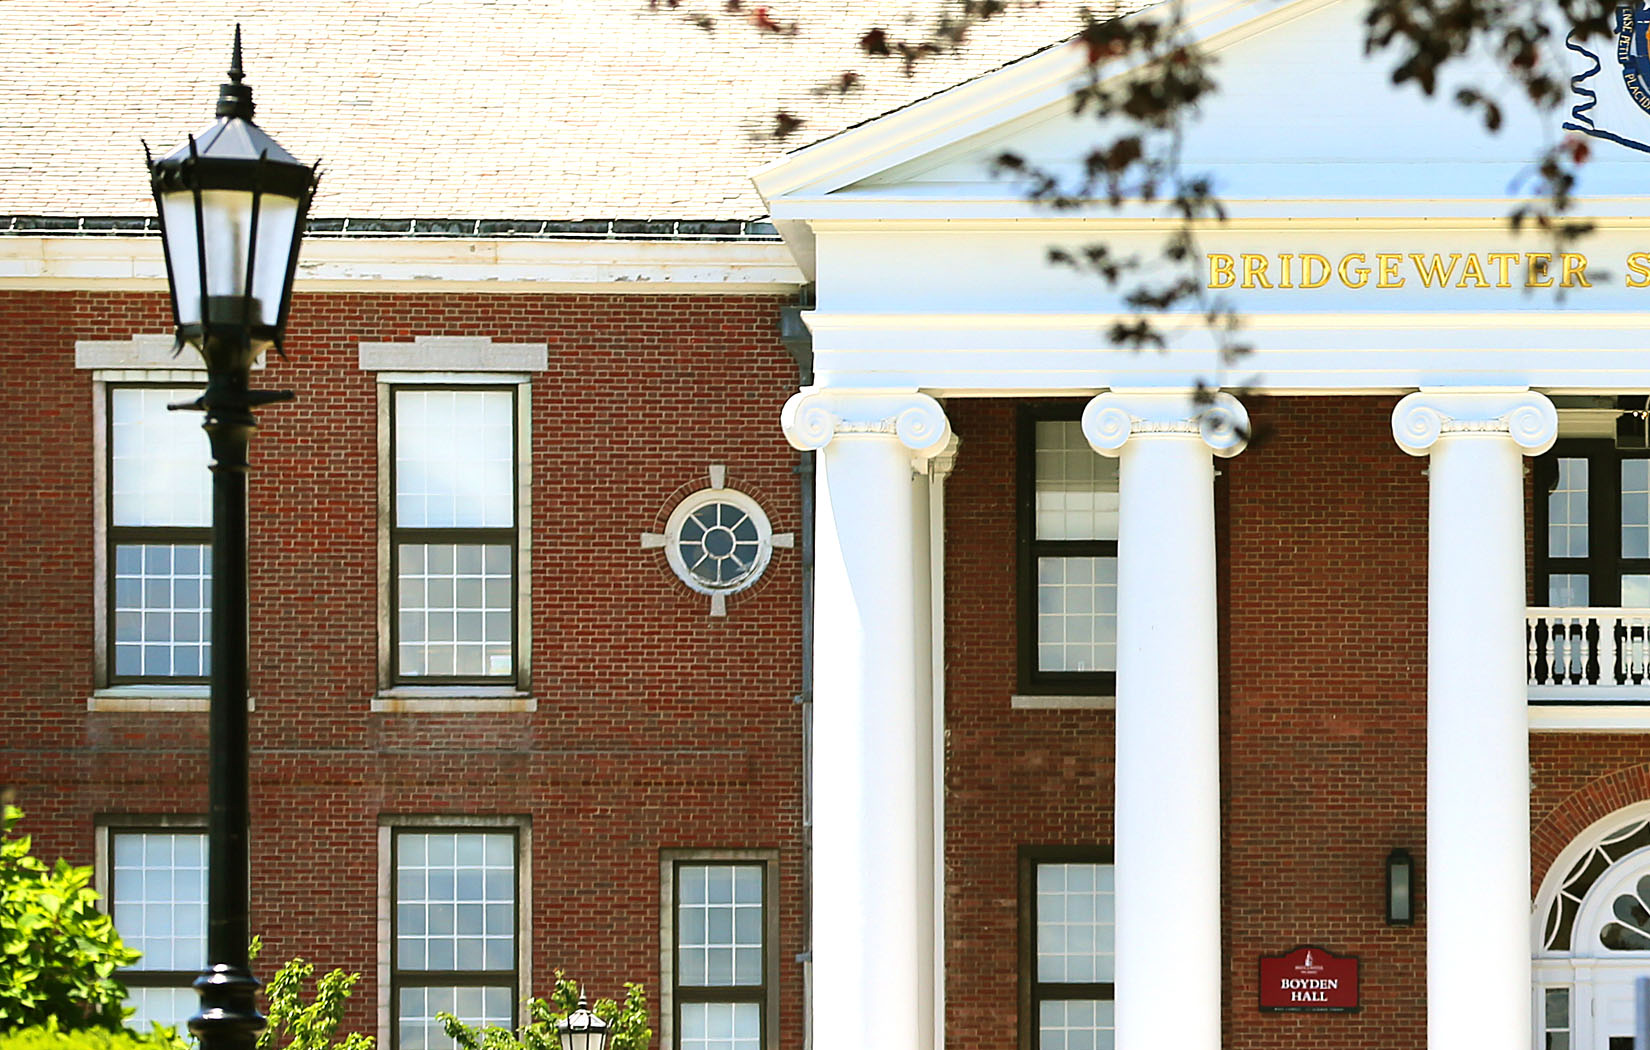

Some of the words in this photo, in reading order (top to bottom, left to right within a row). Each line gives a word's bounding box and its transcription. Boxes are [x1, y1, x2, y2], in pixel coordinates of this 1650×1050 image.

[1622, 9, 1633, 33] ENSE
[1618, 35, 1631, 61] PETIT
[1206, 253, 1592, 288] BRIDGEWATER
[1281, 978, 1338, 989] BOYDEN
[1291, 991, 1328, 1002] HALL
